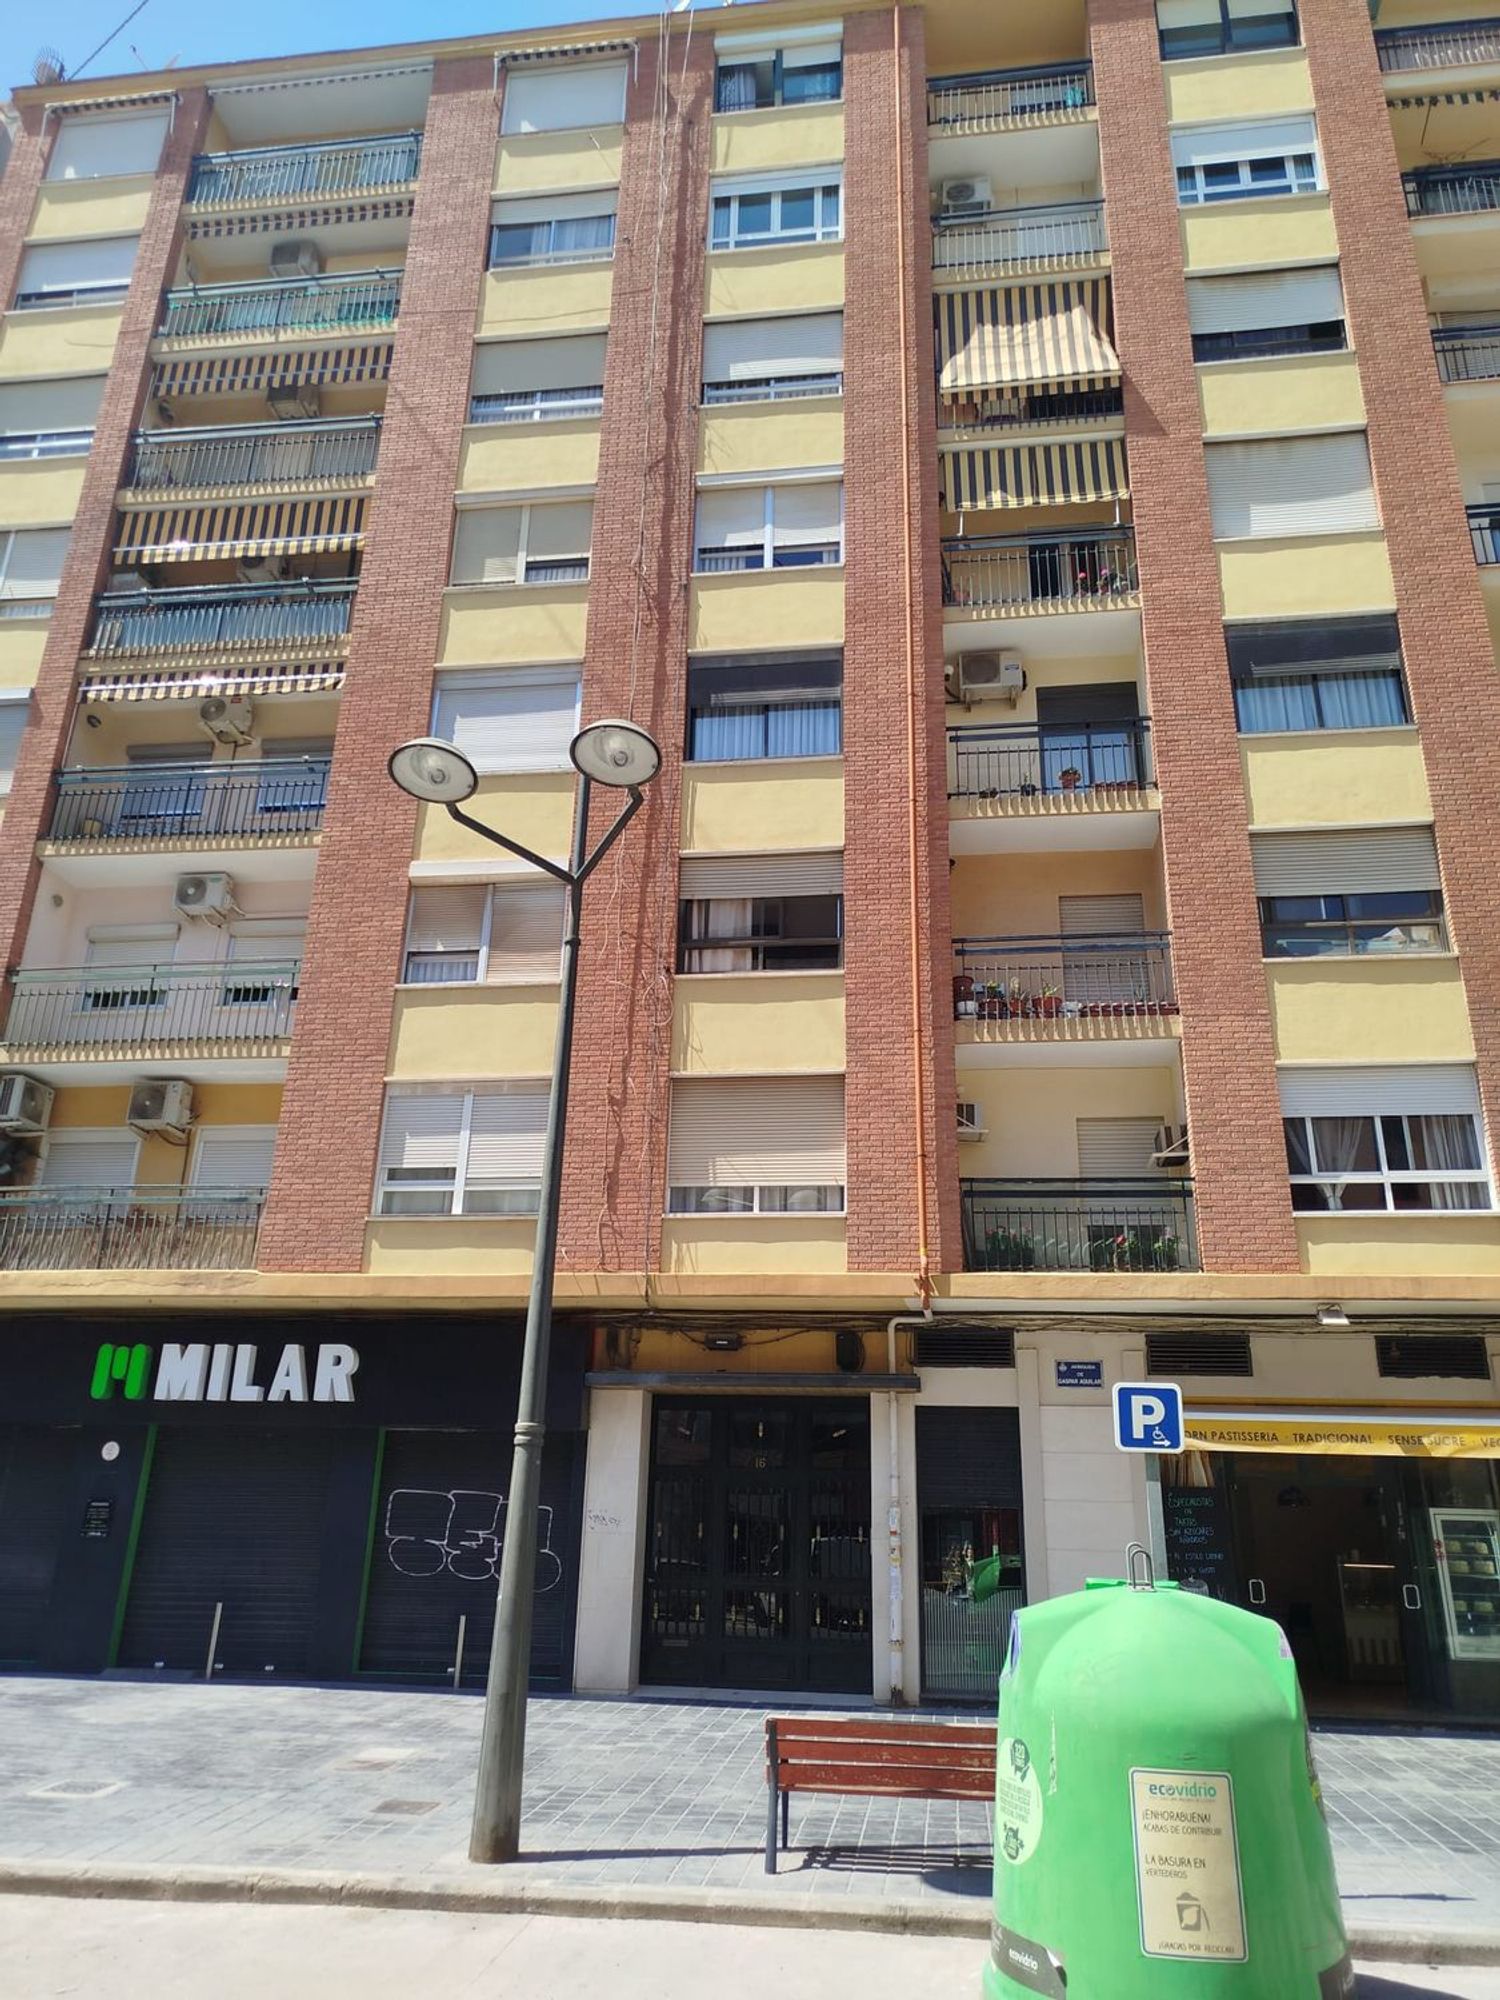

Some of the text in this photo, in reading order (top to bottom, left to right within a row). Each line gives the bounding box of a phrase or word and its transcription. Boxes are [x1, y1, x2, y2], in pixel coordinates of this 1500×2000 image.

[154, 1343, 359, 1402] MILAR
[1130, 1394, 1166, 1439] P
[1184, 1430, 1207, 1441] ORN
[1211, 1430, 1279, 1443] PASTISSERIA
[1293, 1433, 1373, 1445] TRADICIONAL
[1388, 1434, 1424, 1446] SENSE
[1427, 1435, 1467, 1447] SUCRE
[755, 1456, 767, 1470] 16
[1149, 1781, 1217, 1797] ecovidrio
[1144, 1823, 1169, 1834] ACABAS
[1170, 1825, 1180, 1835] DE
[1145, 1854, 1206, 1869] LA BASURA EN
[1146, 1868, 1188, 1879] VERTEDEROS
